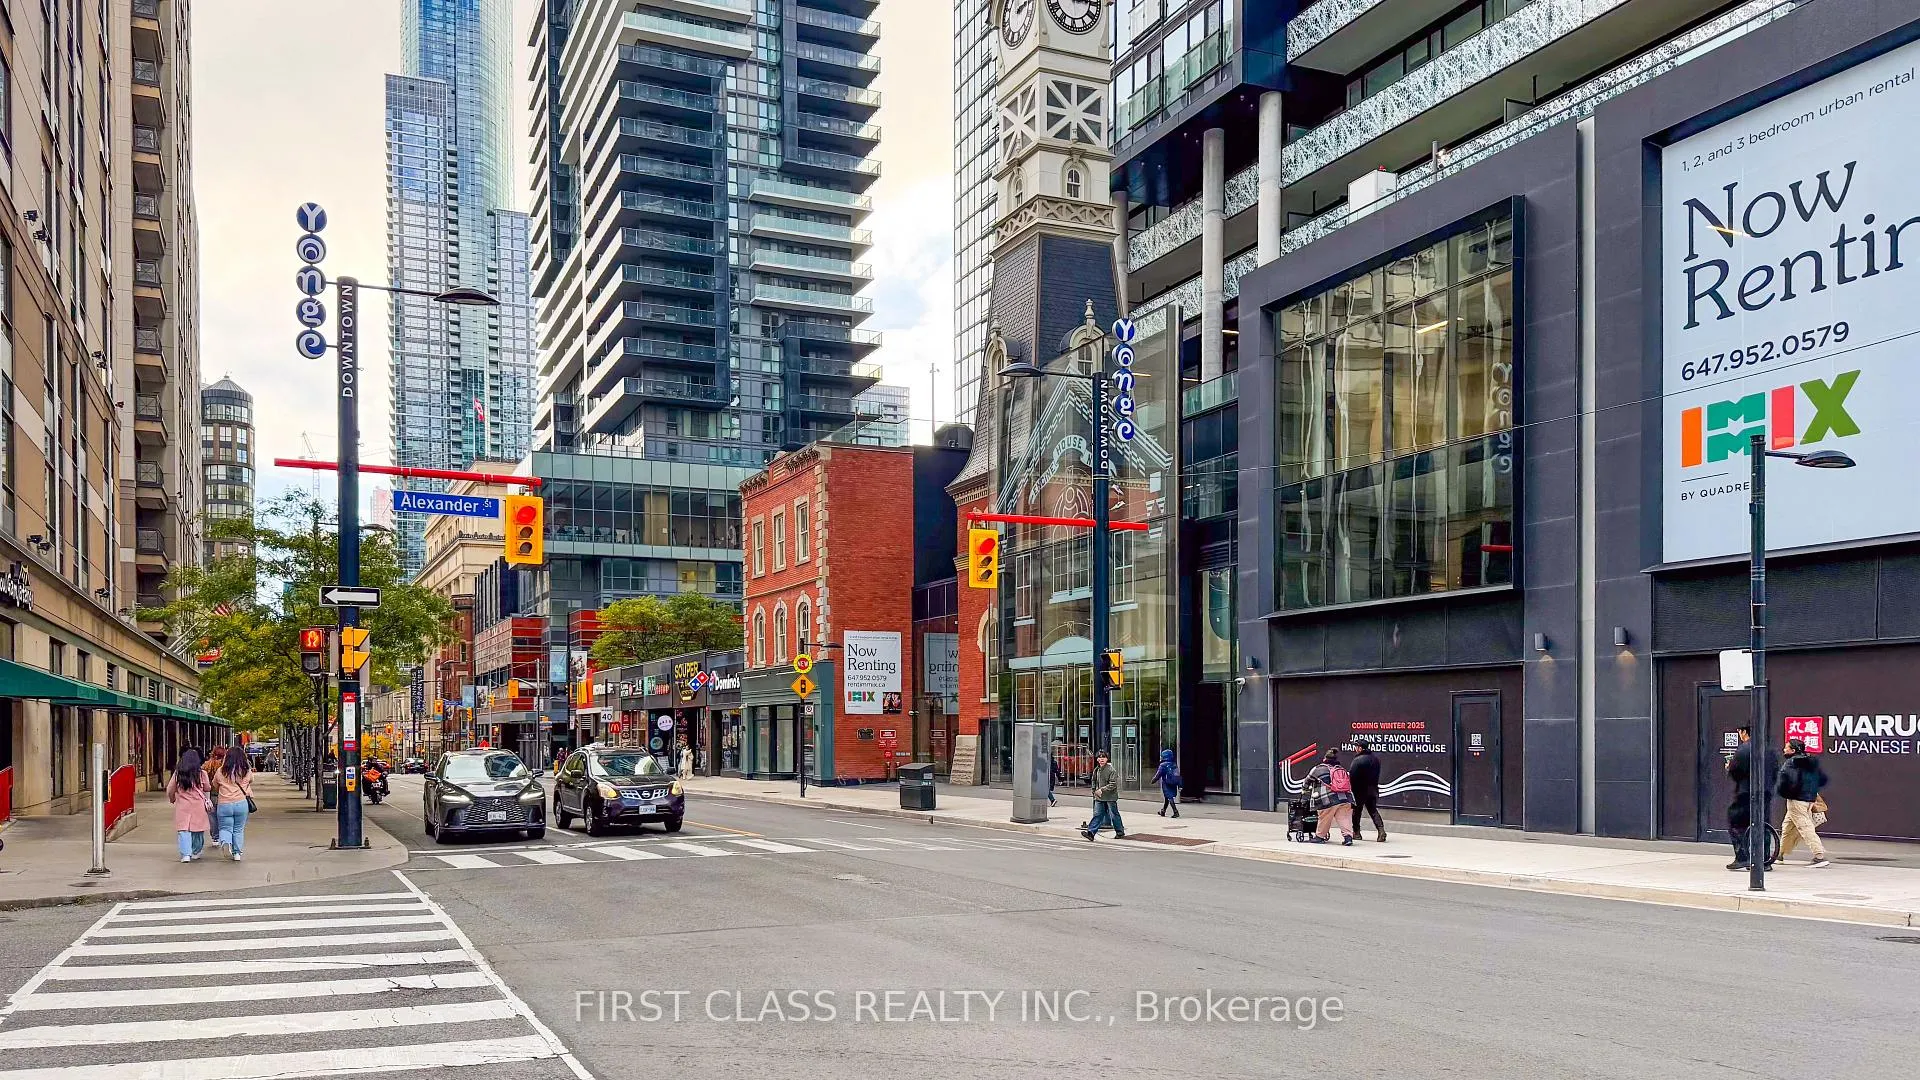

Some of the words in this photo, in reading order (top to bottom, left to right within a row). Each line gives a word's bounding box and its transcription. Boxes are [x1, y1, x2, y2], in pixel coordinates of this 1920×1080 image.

[1682, 160, 1690, 172] 1,
[1693, 155, 1704, 168] 2,
[1707, 142, 1733, 161] and
[1737, 137, 1745, 150] 3
[1749, 110, 1815, 145] bedroom
[1819, 90, 1864, 117] urban
[1869, 67, 1915, 98] rental
[1682, 160, 1857, 262] Now
[297, 203, 327, 358] Yonge
[342, 284, 354, 398] DOWNTOWN
[1681, 321, 1850, 381] 647.952.0579
[1114, 319, 1135, 442] Yonge
[1056, 436, 1083, 455] HOUSE
[1681, 490, 1695, 501] BY
[1700, 482, 1750, 498] QUADRE
[401, 493, 479, 513] Alexander
[484, 500, 492, 508] St
[848, 643, 877, 657] Now
[675, 661, 699, 679] SOUPER
[848, 657, 896, 674] Renting
[714, 673, 741, 691] Domino's
[1407, 721, 1425, 729] 2025
[1828, 715, 1920, 737] MARU
[1341, 743, 1387, 752] HANADE
[1388, 744, 1413, 752] UDON
[1415, 744, 1447, 753] HOUSE
[1350, 734, 1382, 743] JAPAN'S
[1383, 734, 1431, 743] FAVOURITE
[1828, 740, 1910, 754] JAPANESE
